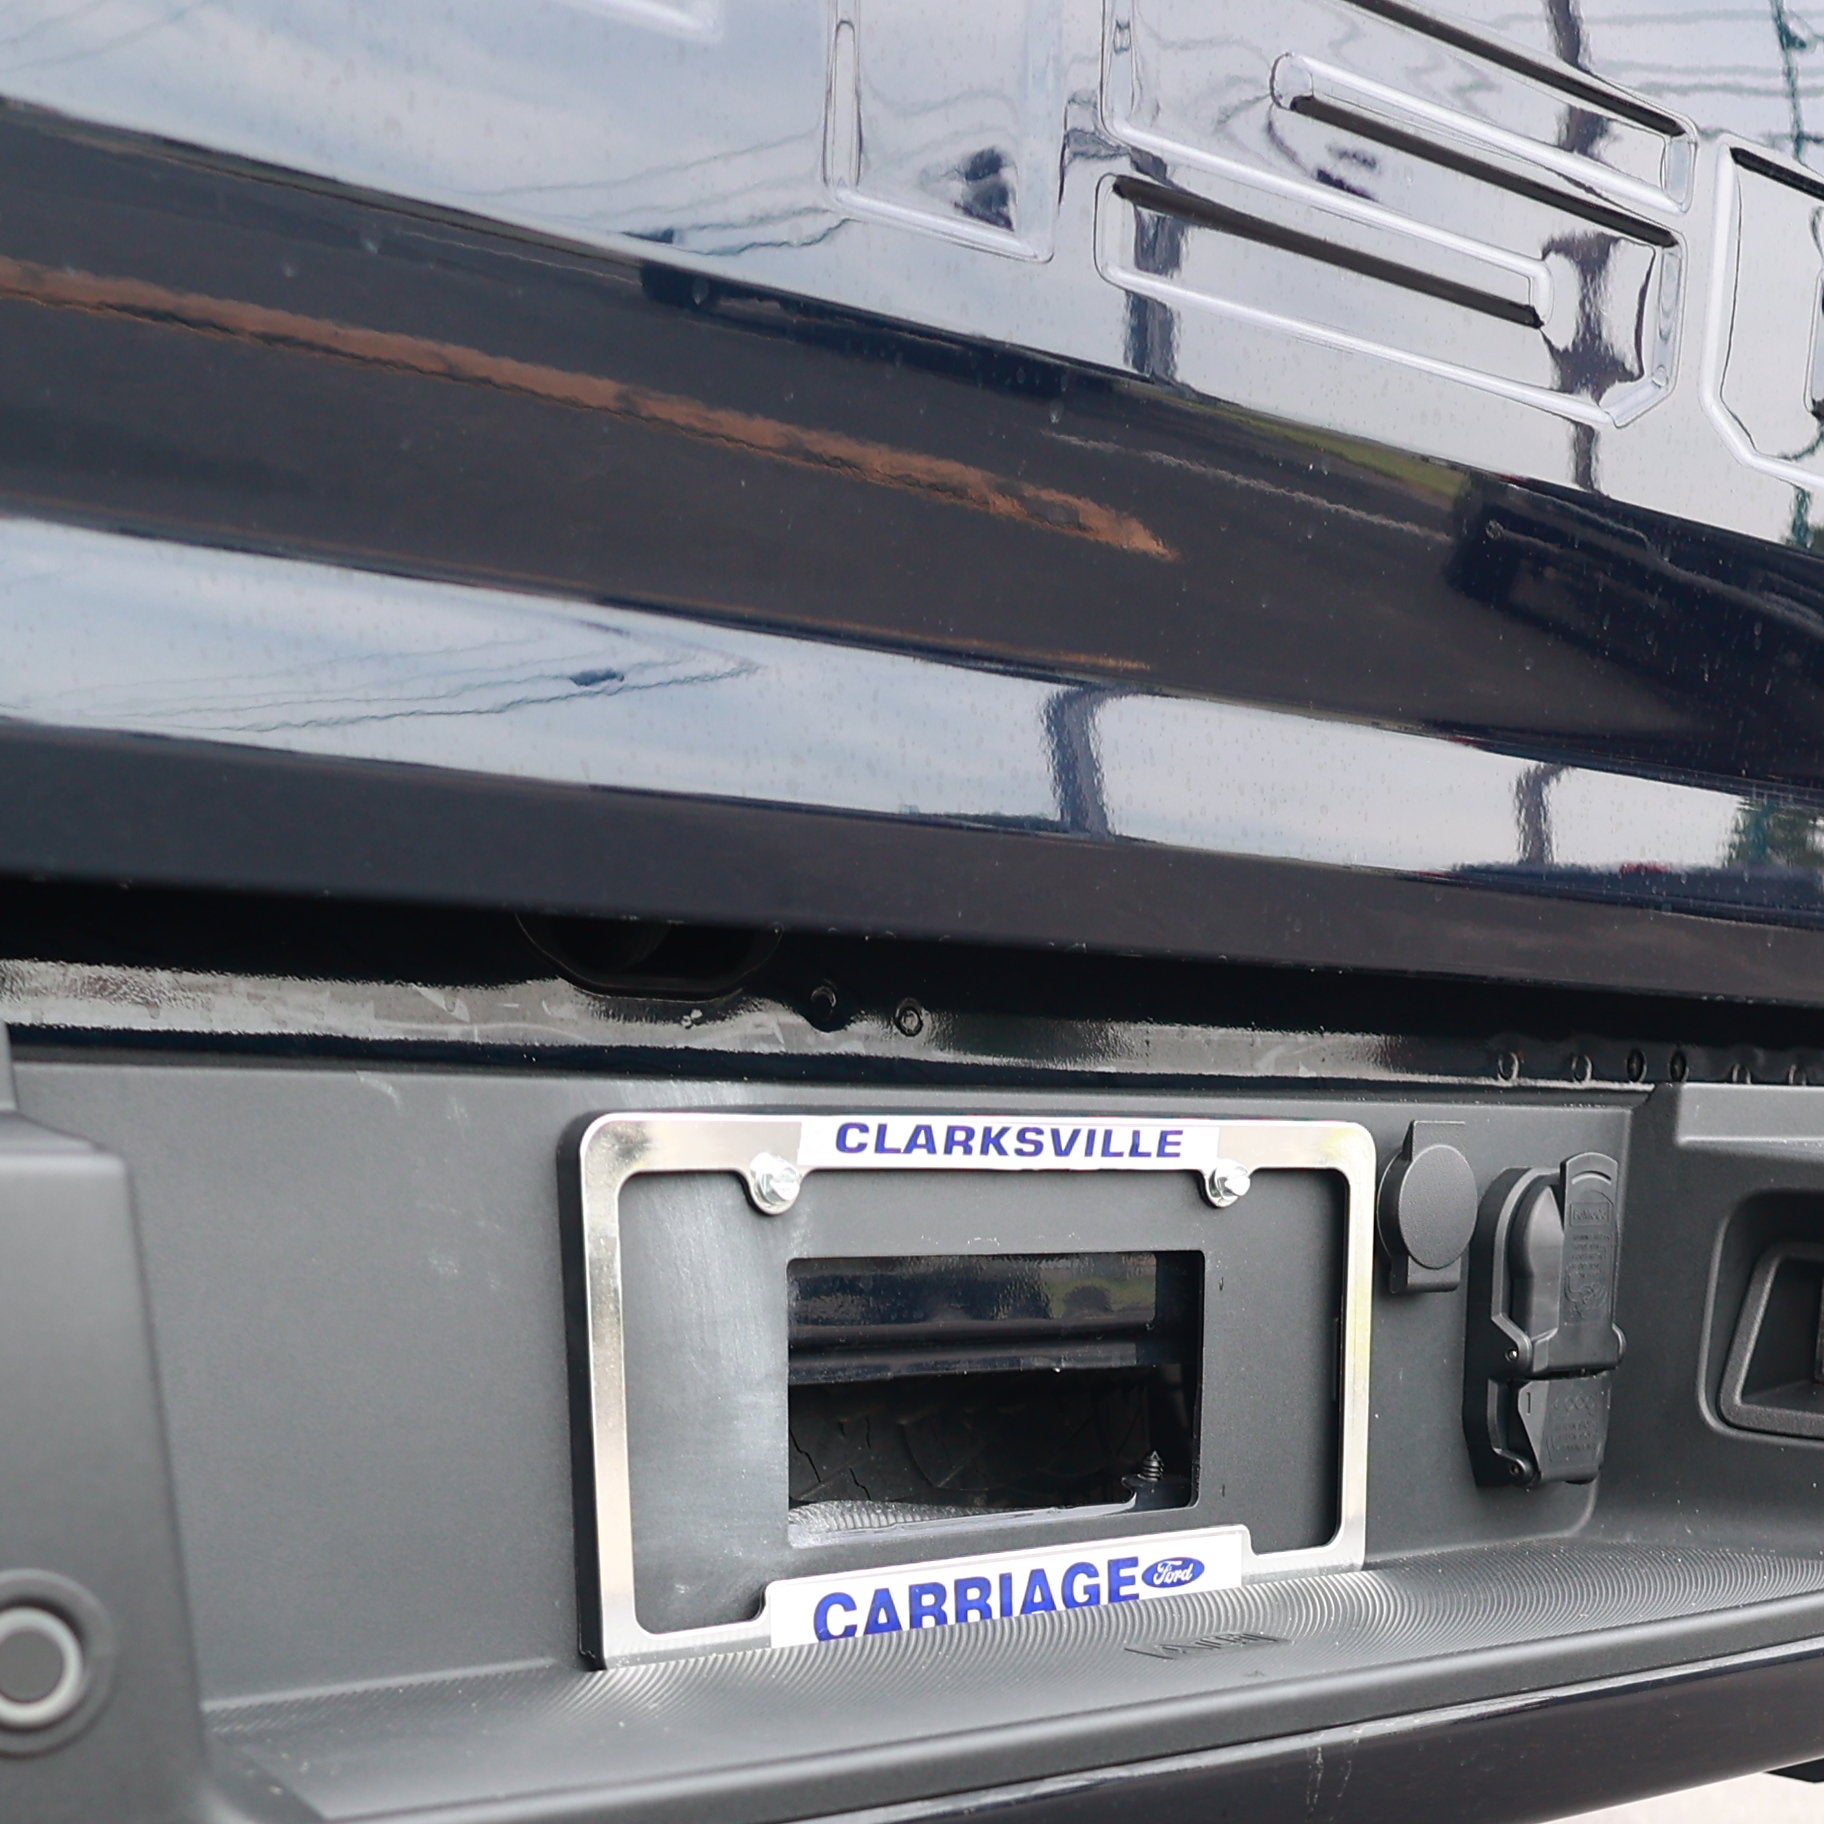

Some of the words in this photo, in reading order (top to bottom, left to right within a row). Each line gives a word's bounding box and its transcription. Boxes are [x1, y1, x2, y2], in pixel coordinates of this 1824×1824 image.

[835, 1122, 1184, 1158] CLARKSVILLE
[813, 1556, 1139, 1642] CARRIAGE
[1150, 1559, 1196, 1586] Ford
